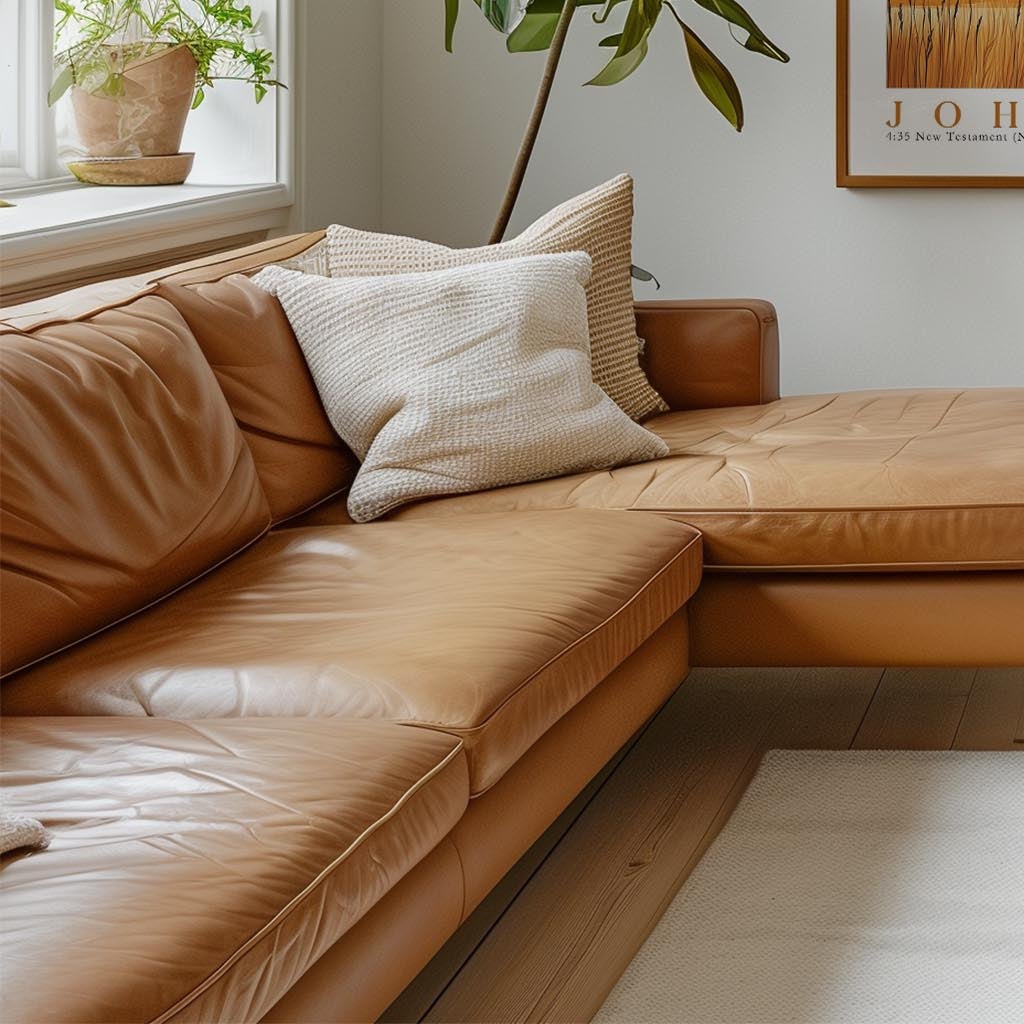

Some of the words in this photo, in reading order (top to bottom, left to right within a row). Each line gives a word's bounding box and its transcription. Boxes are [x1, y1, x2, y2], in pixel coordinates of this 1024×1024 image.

[885, 131, 911, 142] 4:35
[915, 131, 942, 142] New
[946, 131, 1008, 142] Testament
